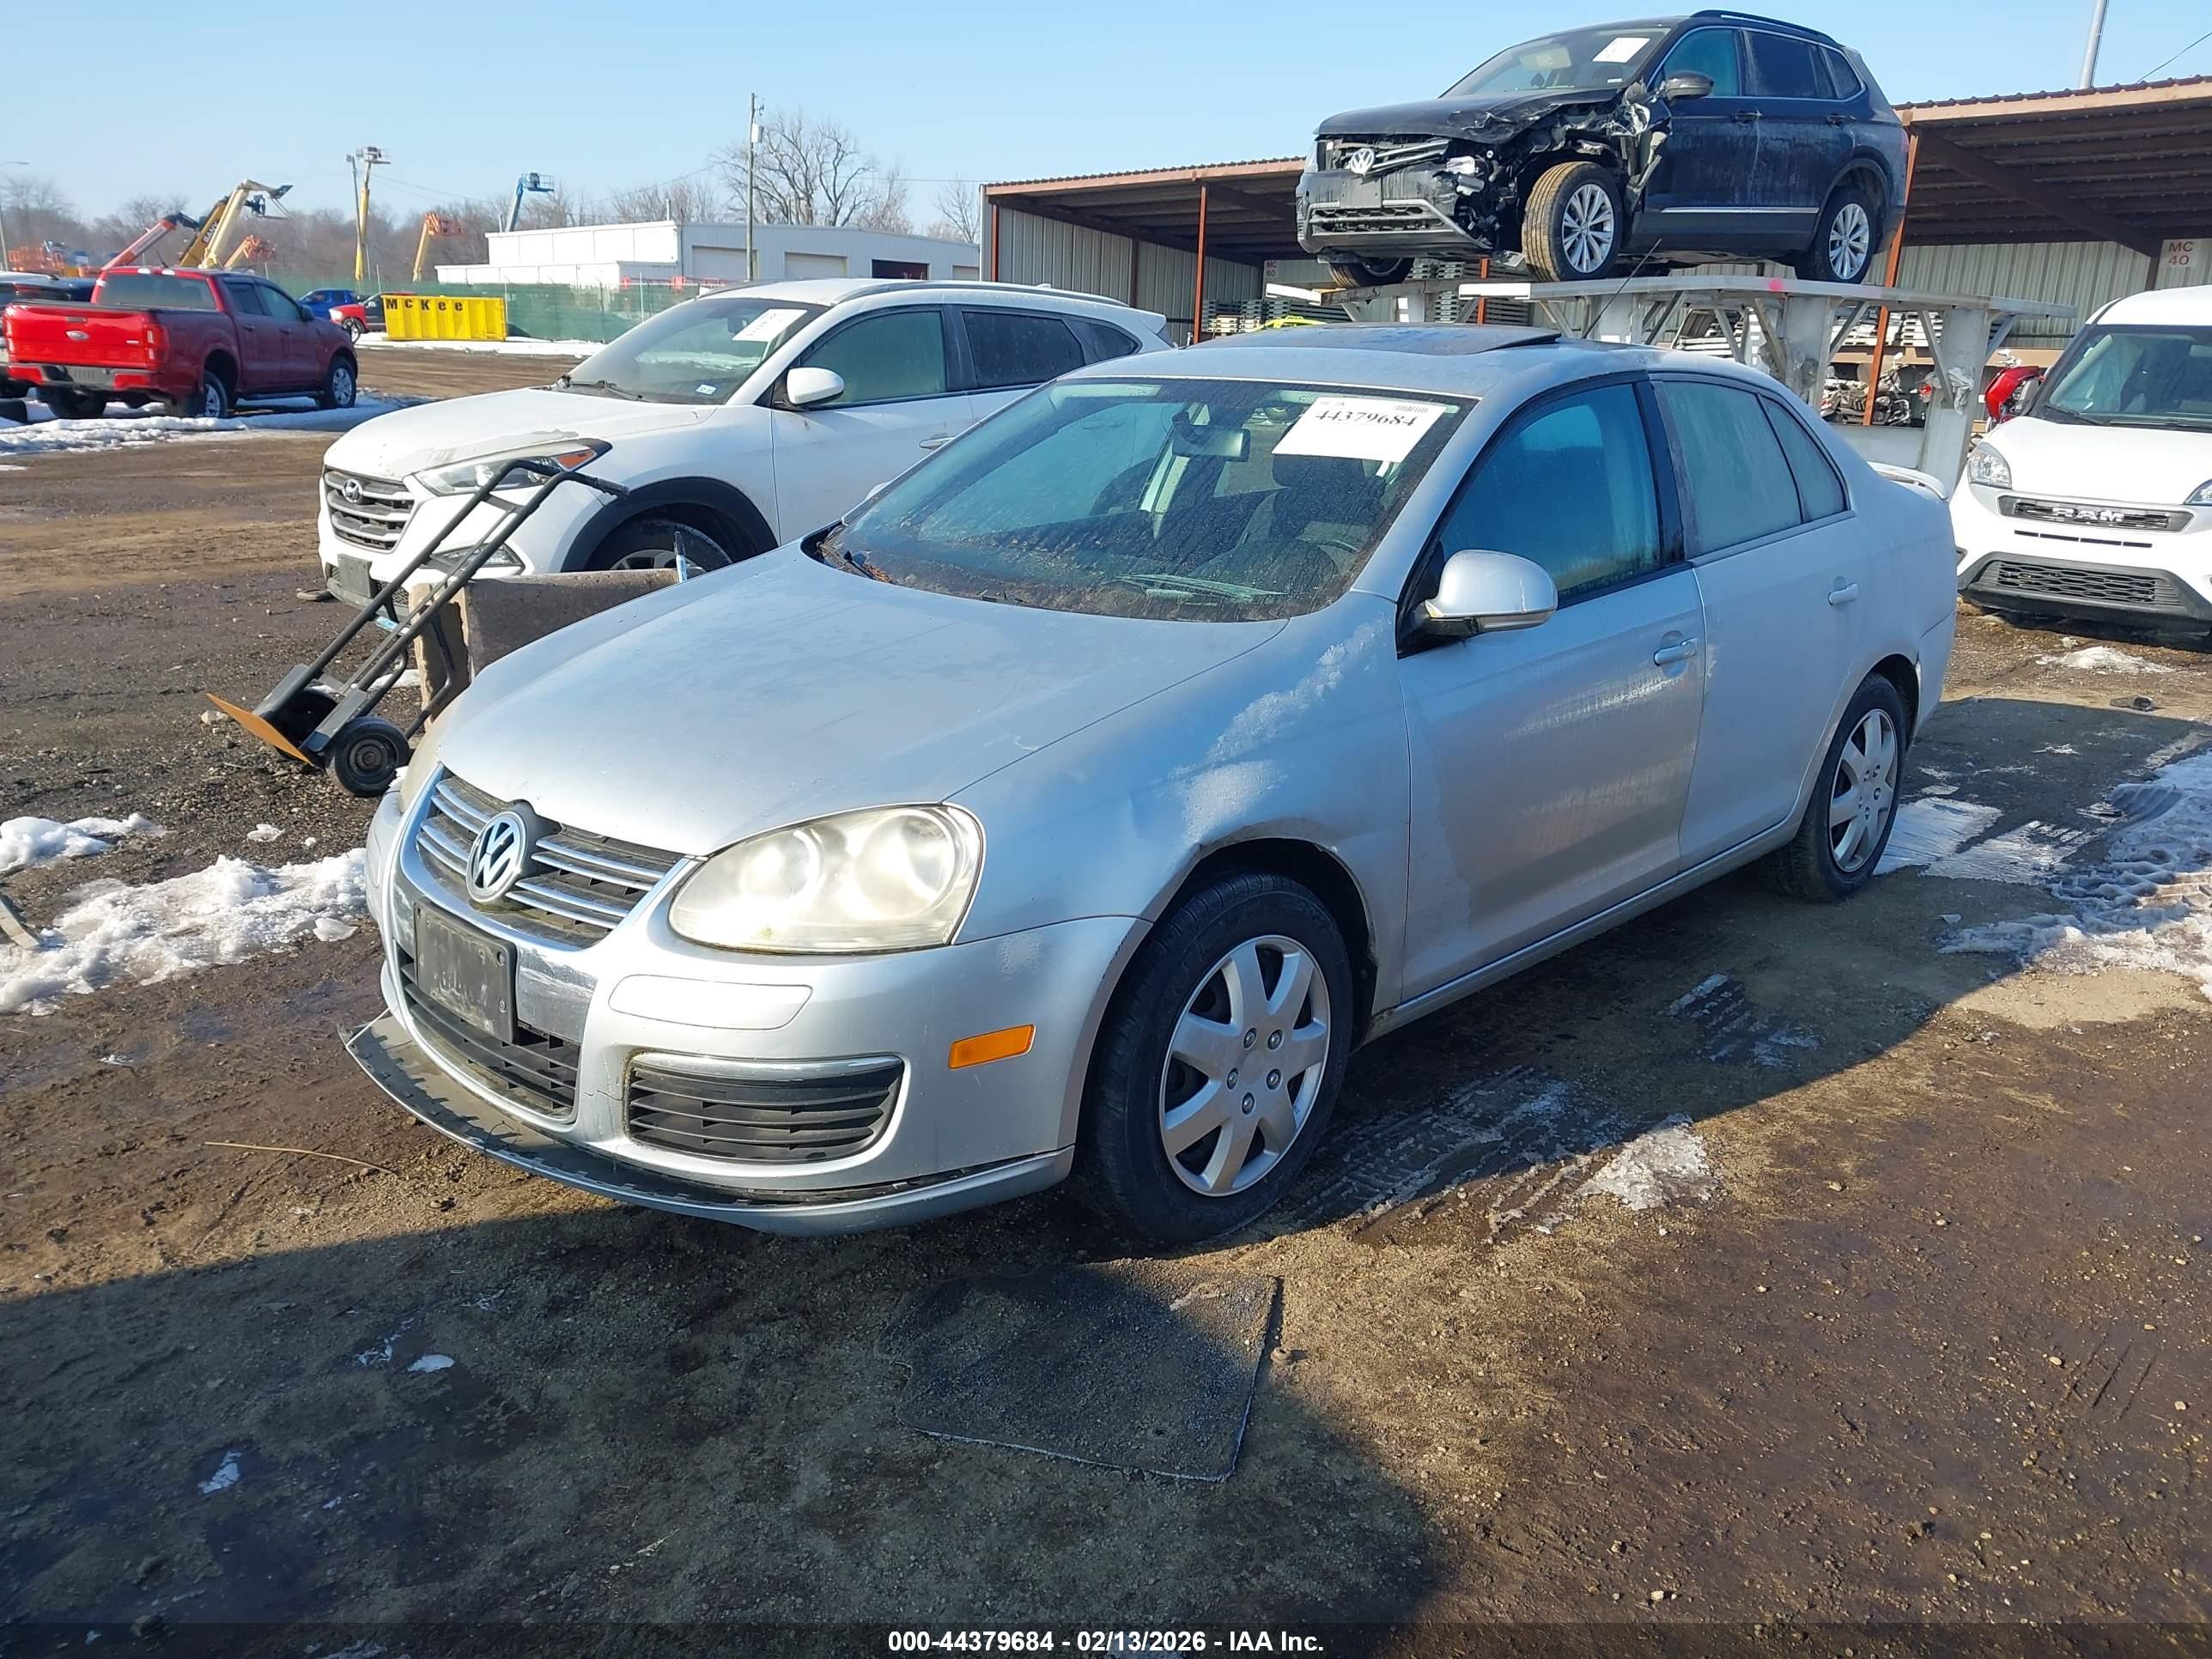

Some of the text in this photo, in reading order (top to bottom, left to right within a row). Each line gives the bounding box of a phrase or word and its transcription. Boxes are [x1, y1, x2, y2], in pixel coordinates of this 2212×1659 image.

[2169, 241, 2194, 252] MC
[2168, 255, 2190, 265] 40
[1315, 410, 1419, 427] 44379684
[2051, 507, 2124, 523] RAM
